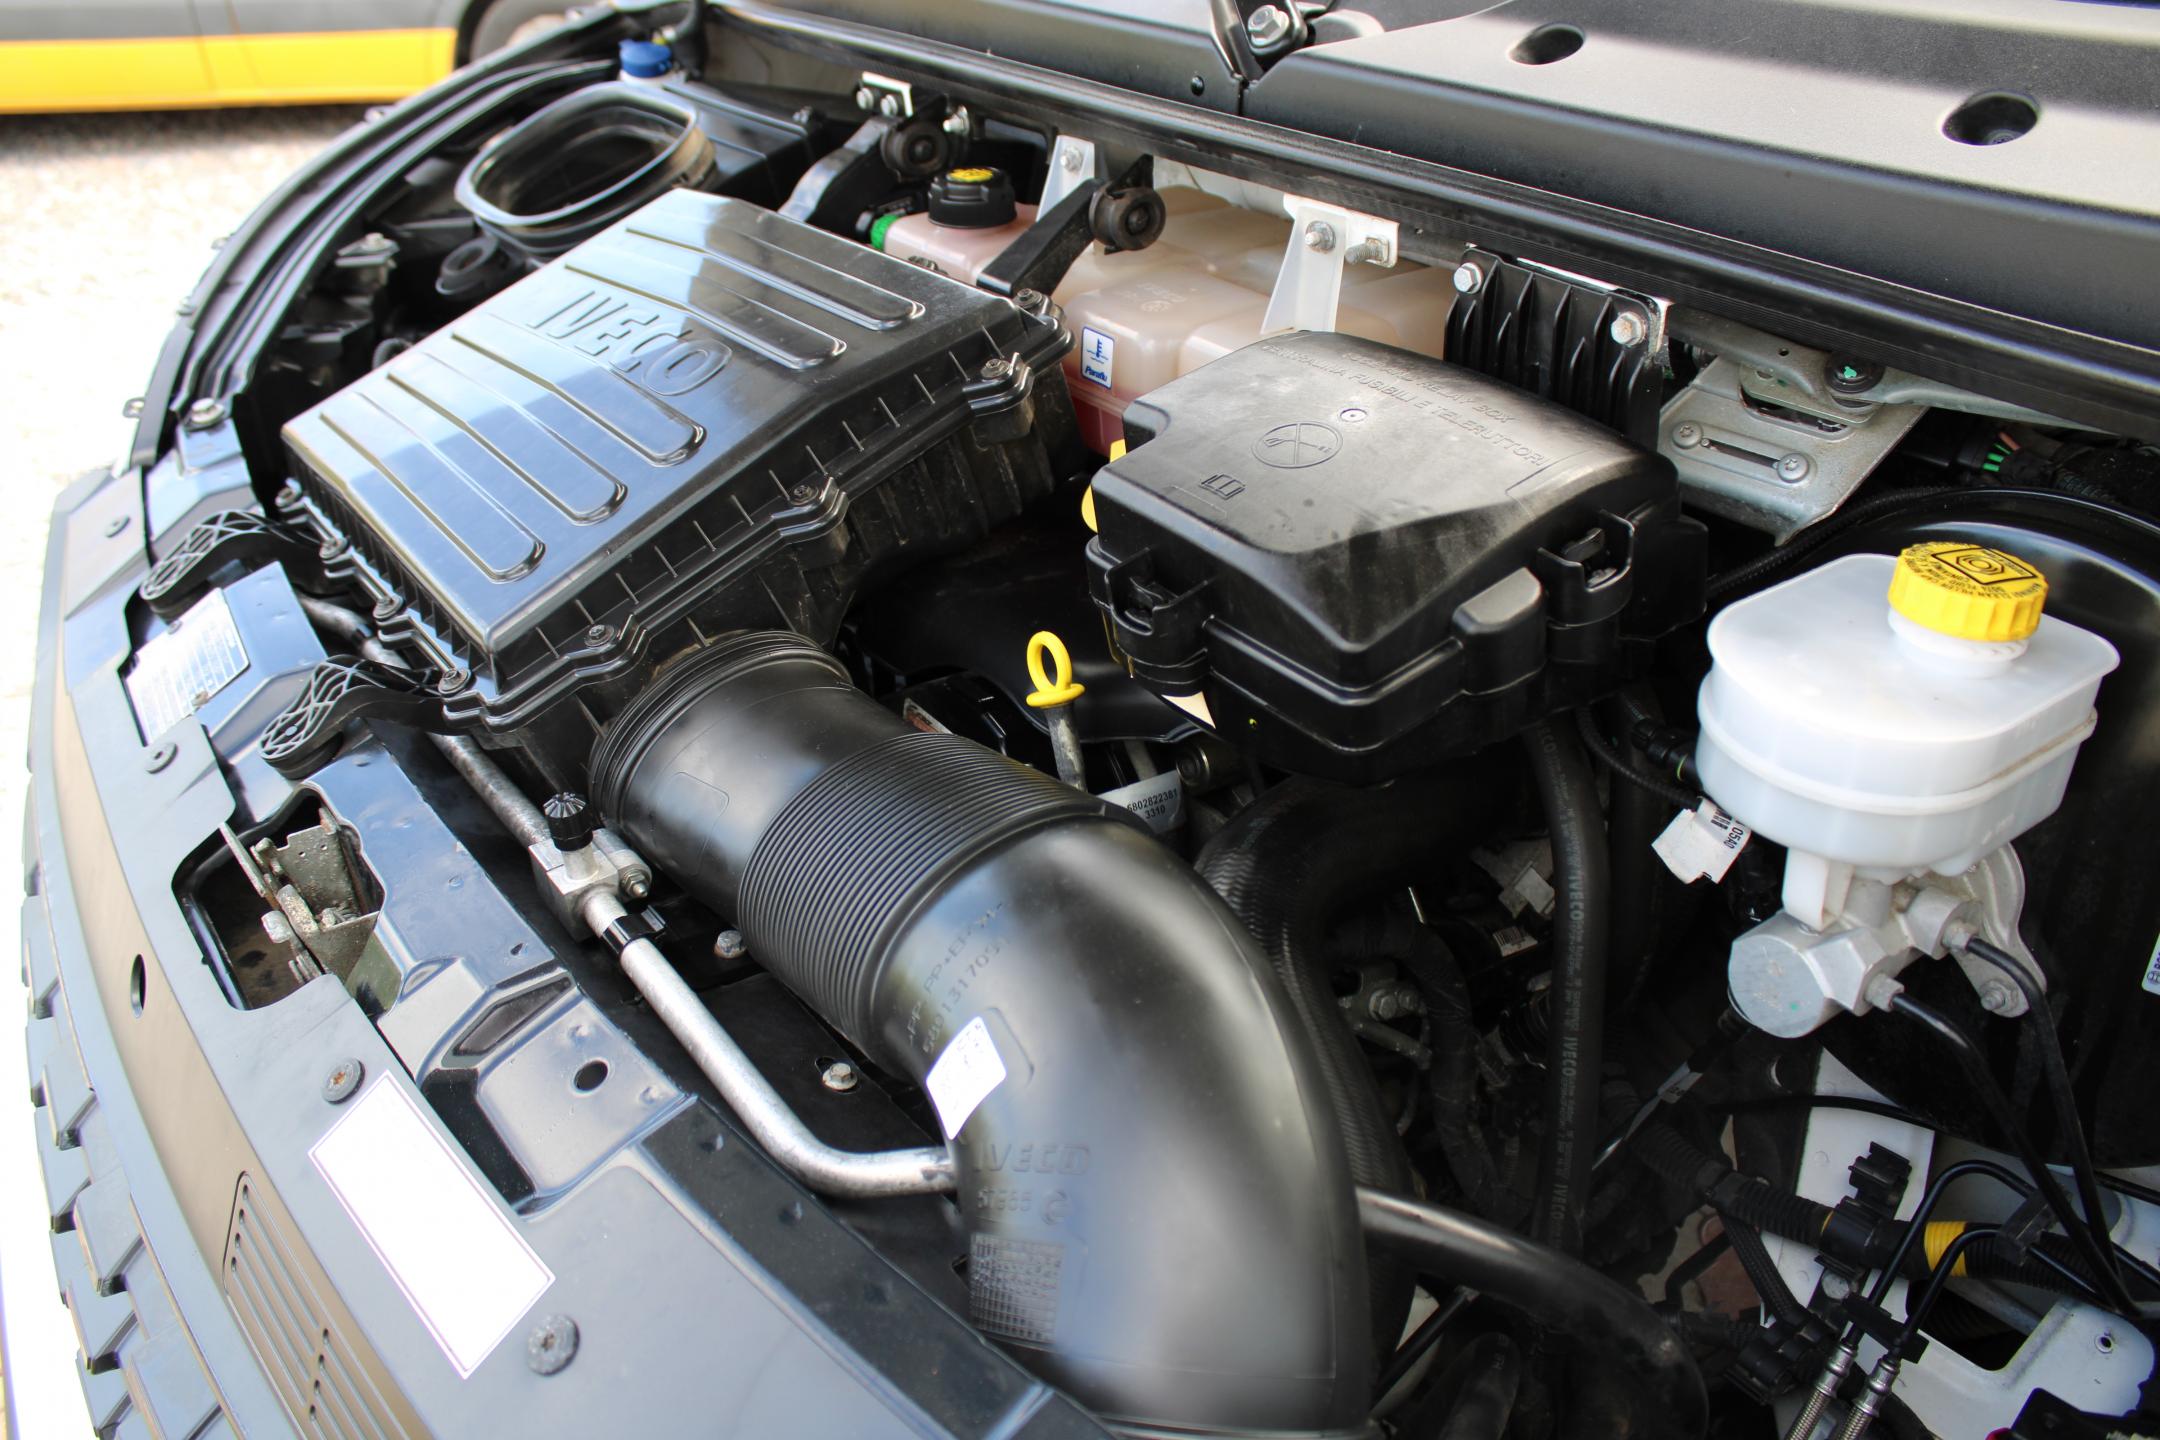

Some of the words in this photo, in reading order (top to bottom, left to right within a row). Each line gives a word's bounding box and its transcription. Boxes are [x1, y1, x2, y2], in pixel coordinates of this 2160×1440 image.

[525, 290, 733, 397] IVECO
[1349, 373, 1418, 403] FUSIBILI
[1414, 400, 1433, 409] E
[1431, 405, 1551, 467] TELERUTTORI
[1472, 403, 1517, 424] BOX
[1145, 804, 1166, 820] 3310
[1567, 875, 1585, 921] IVECO
[1561, 1036, 1579, 1077] IVECO
[973, 1142, 1092, 1176] IVECO
[1550, 1184, 1569, 1221] IVECO
